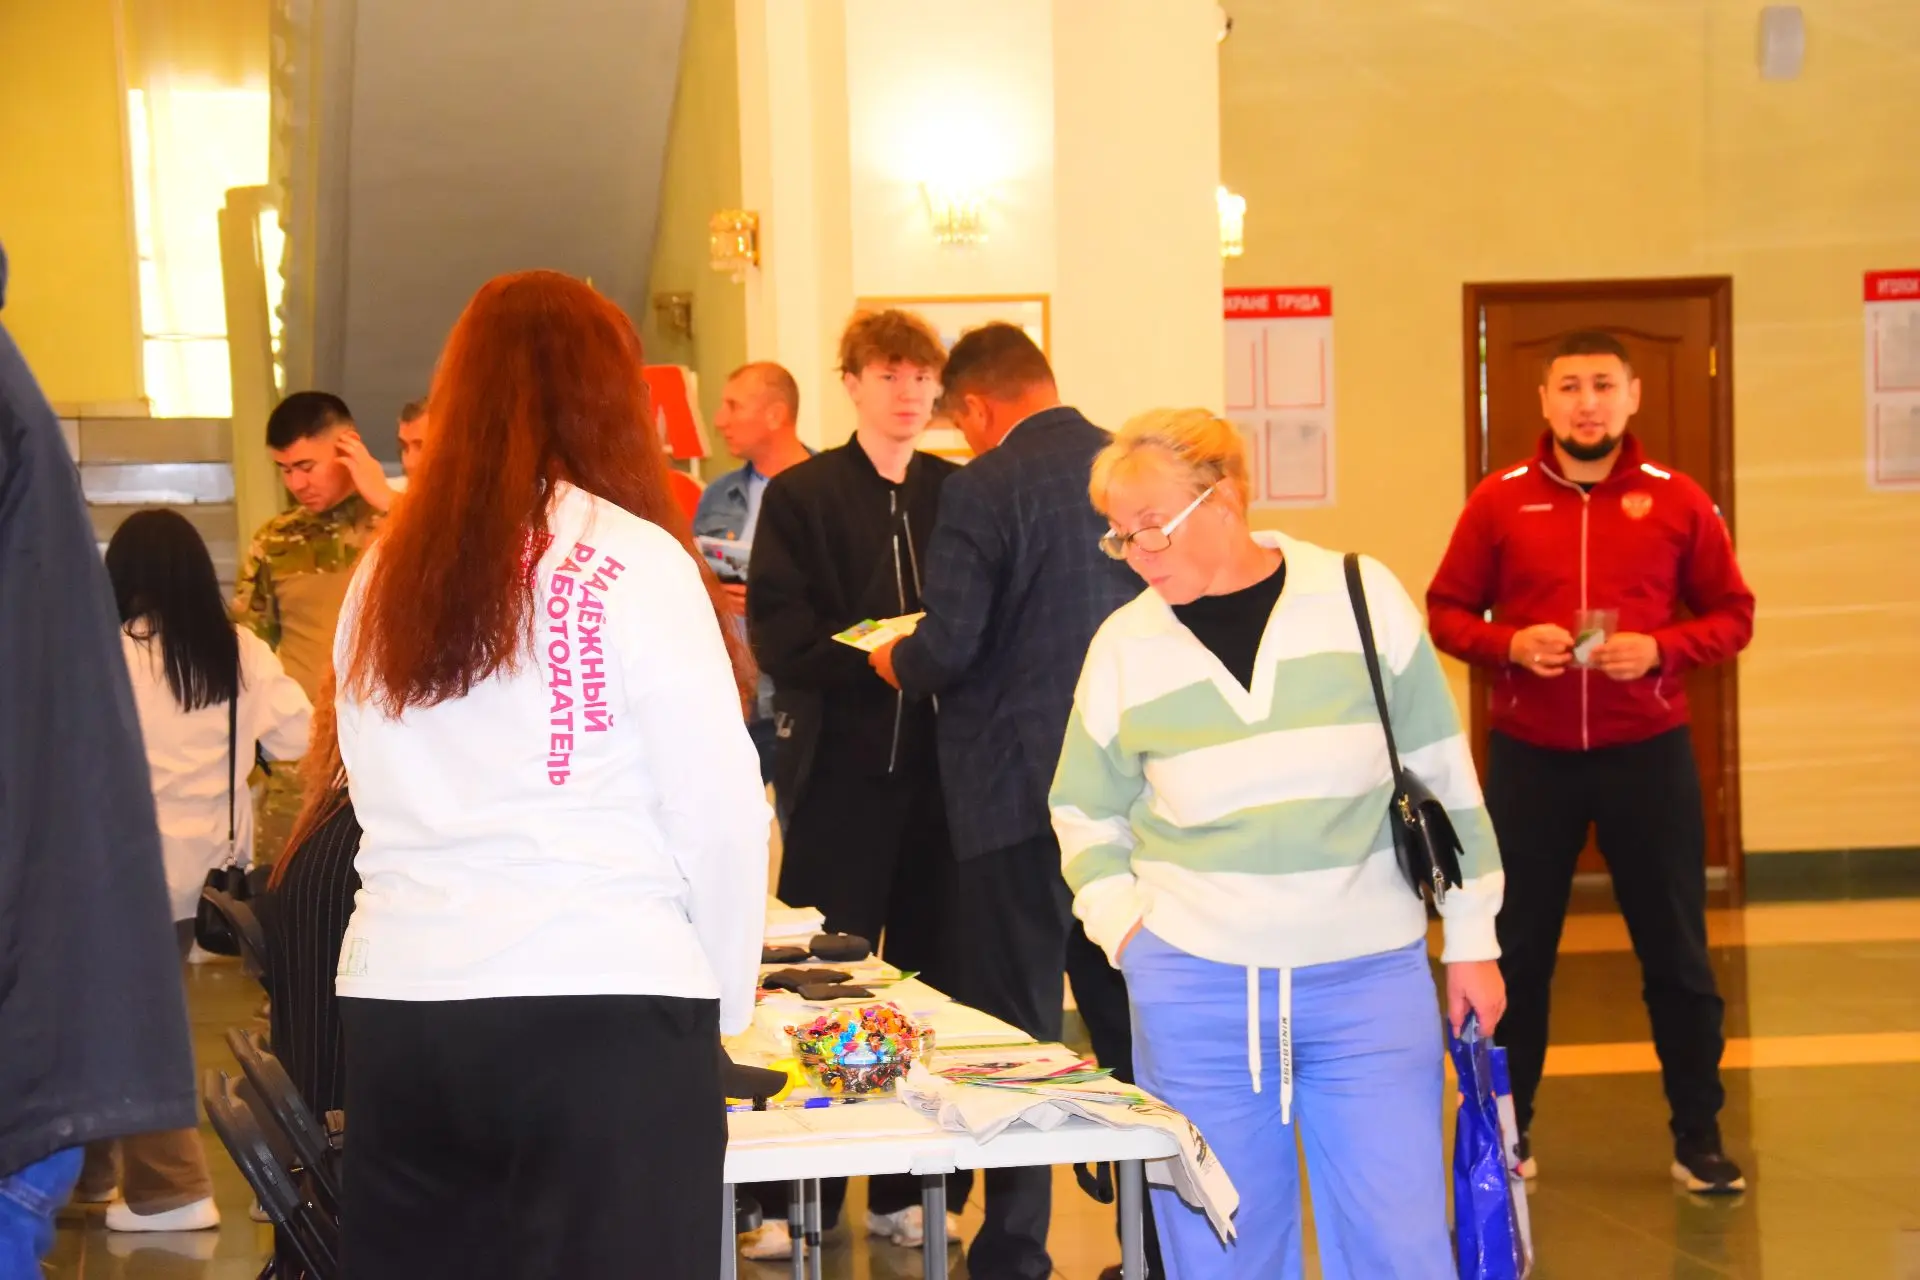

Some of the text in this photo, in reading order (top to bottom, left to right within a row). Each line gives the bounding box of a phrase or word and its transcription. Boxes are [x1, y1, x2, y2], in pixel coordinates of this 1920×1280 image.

[1276, 293, 1321, 311] ТРУДА
[547, 542, 596, 786] РАБОТОДАТЕЛЬ
[577, 555, 626, 732] НАДЁЖНЫЙ
